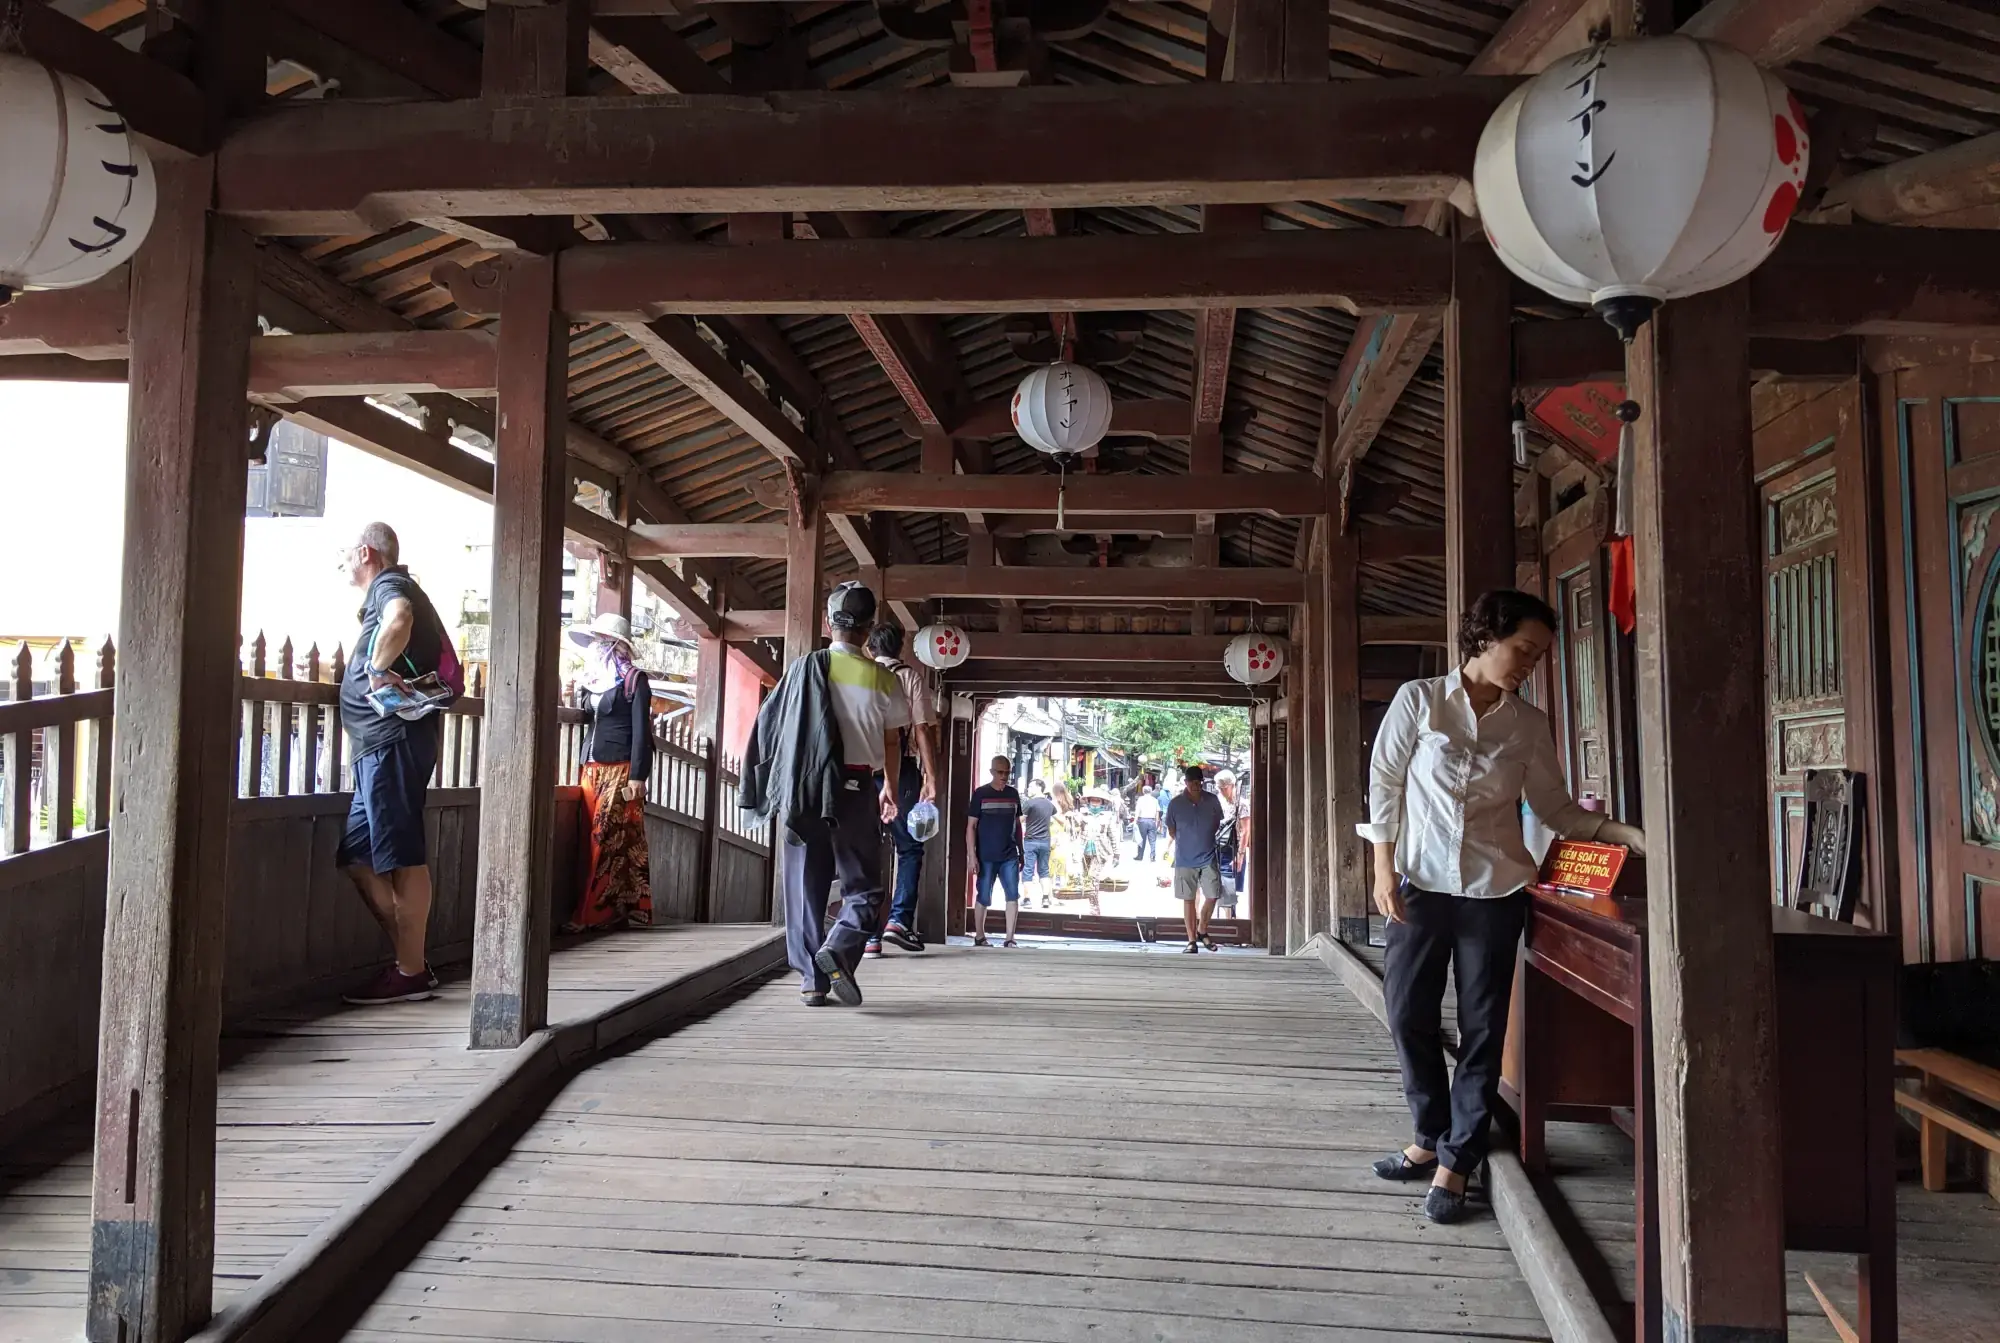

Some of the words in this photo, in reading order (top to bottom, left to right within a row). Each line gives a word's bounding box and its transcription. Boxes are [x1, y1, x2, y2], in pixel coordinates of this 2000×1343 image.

[1577, 851, 1598, 863] SOÁT
[1598, 853, 1610, 865] VÉ
[1575, 863, 1610, 877] CONTROL
